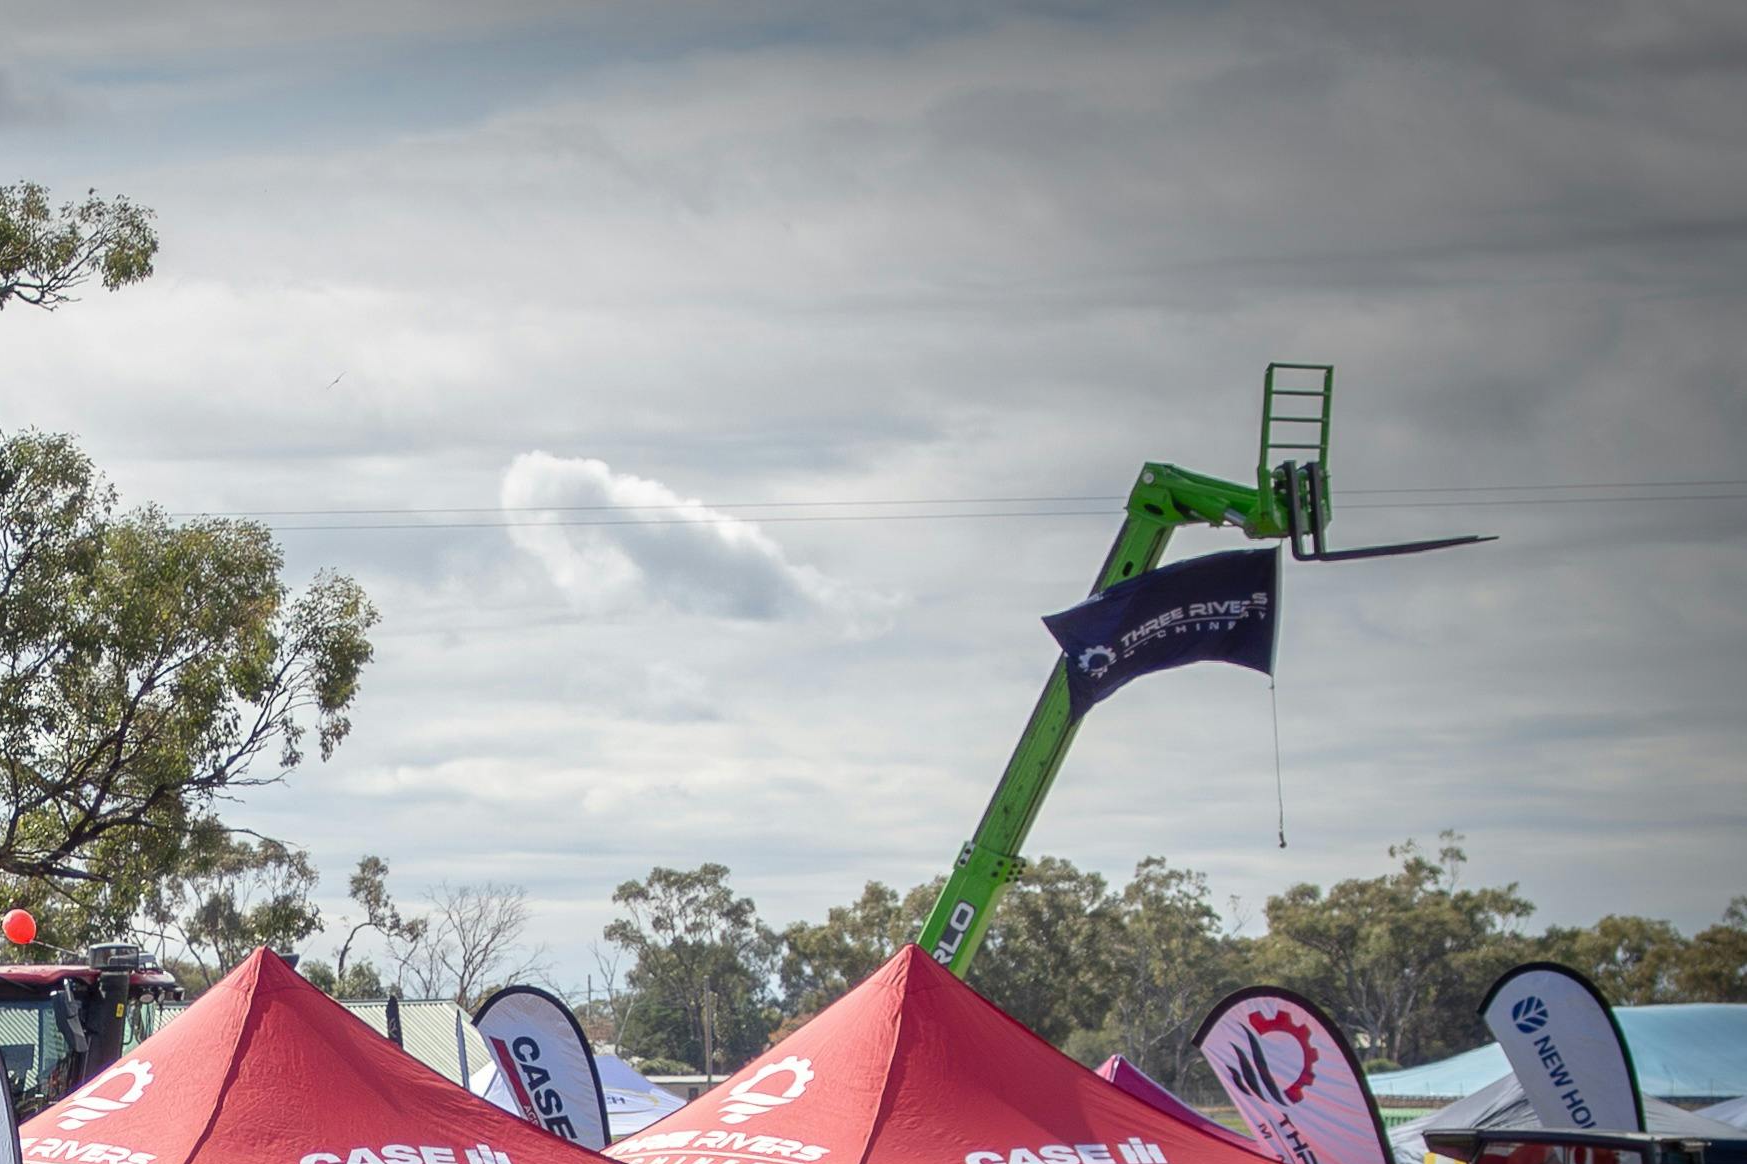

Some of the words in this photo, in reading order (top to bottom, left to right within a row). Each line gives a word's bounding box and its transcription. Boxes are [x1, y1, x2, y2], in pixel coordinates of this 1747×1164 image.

[1121, 606, 1185, 648] THREE
[933, 901, 975, 965] RLO
[512, 1036, 578, 1139] CASE
[1534, 1034, 1574, 1088] NEW
[692, 1130, 831, 1162] RIVERS
